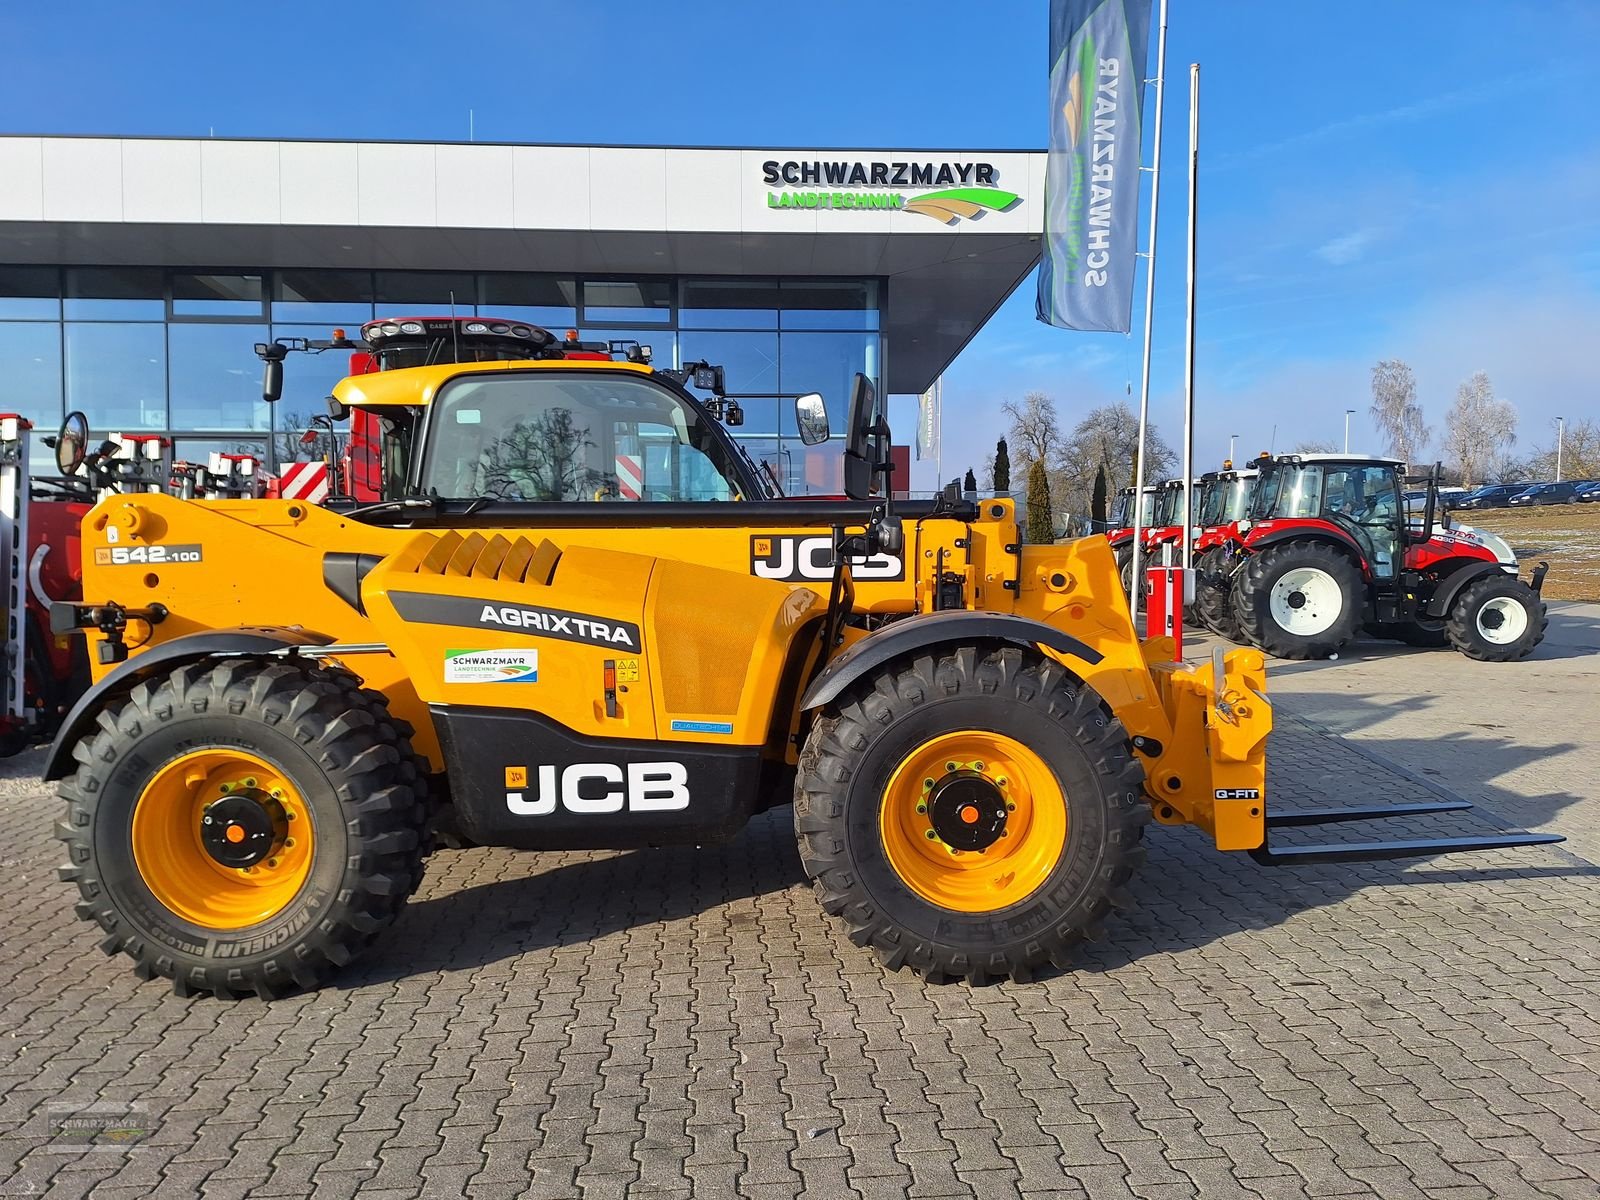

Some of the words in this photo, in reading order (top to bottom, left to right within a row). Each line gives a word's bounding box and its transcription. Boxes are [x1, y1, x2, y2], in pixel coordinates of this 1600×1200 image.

[762, 161, 994, 185] SCHWARZMAYR
[767, 192, 902, 209] LANDTECHNIK
[480, 605, 634, 646] AGRIXTRA
[453, 657, 526, 665] SCHWARZMAYR
[506, 762, 690, 815] JCB
[1216, 790, 1258, 798] Q-FIT
[213, 912, 310, 958] MICHELIN
